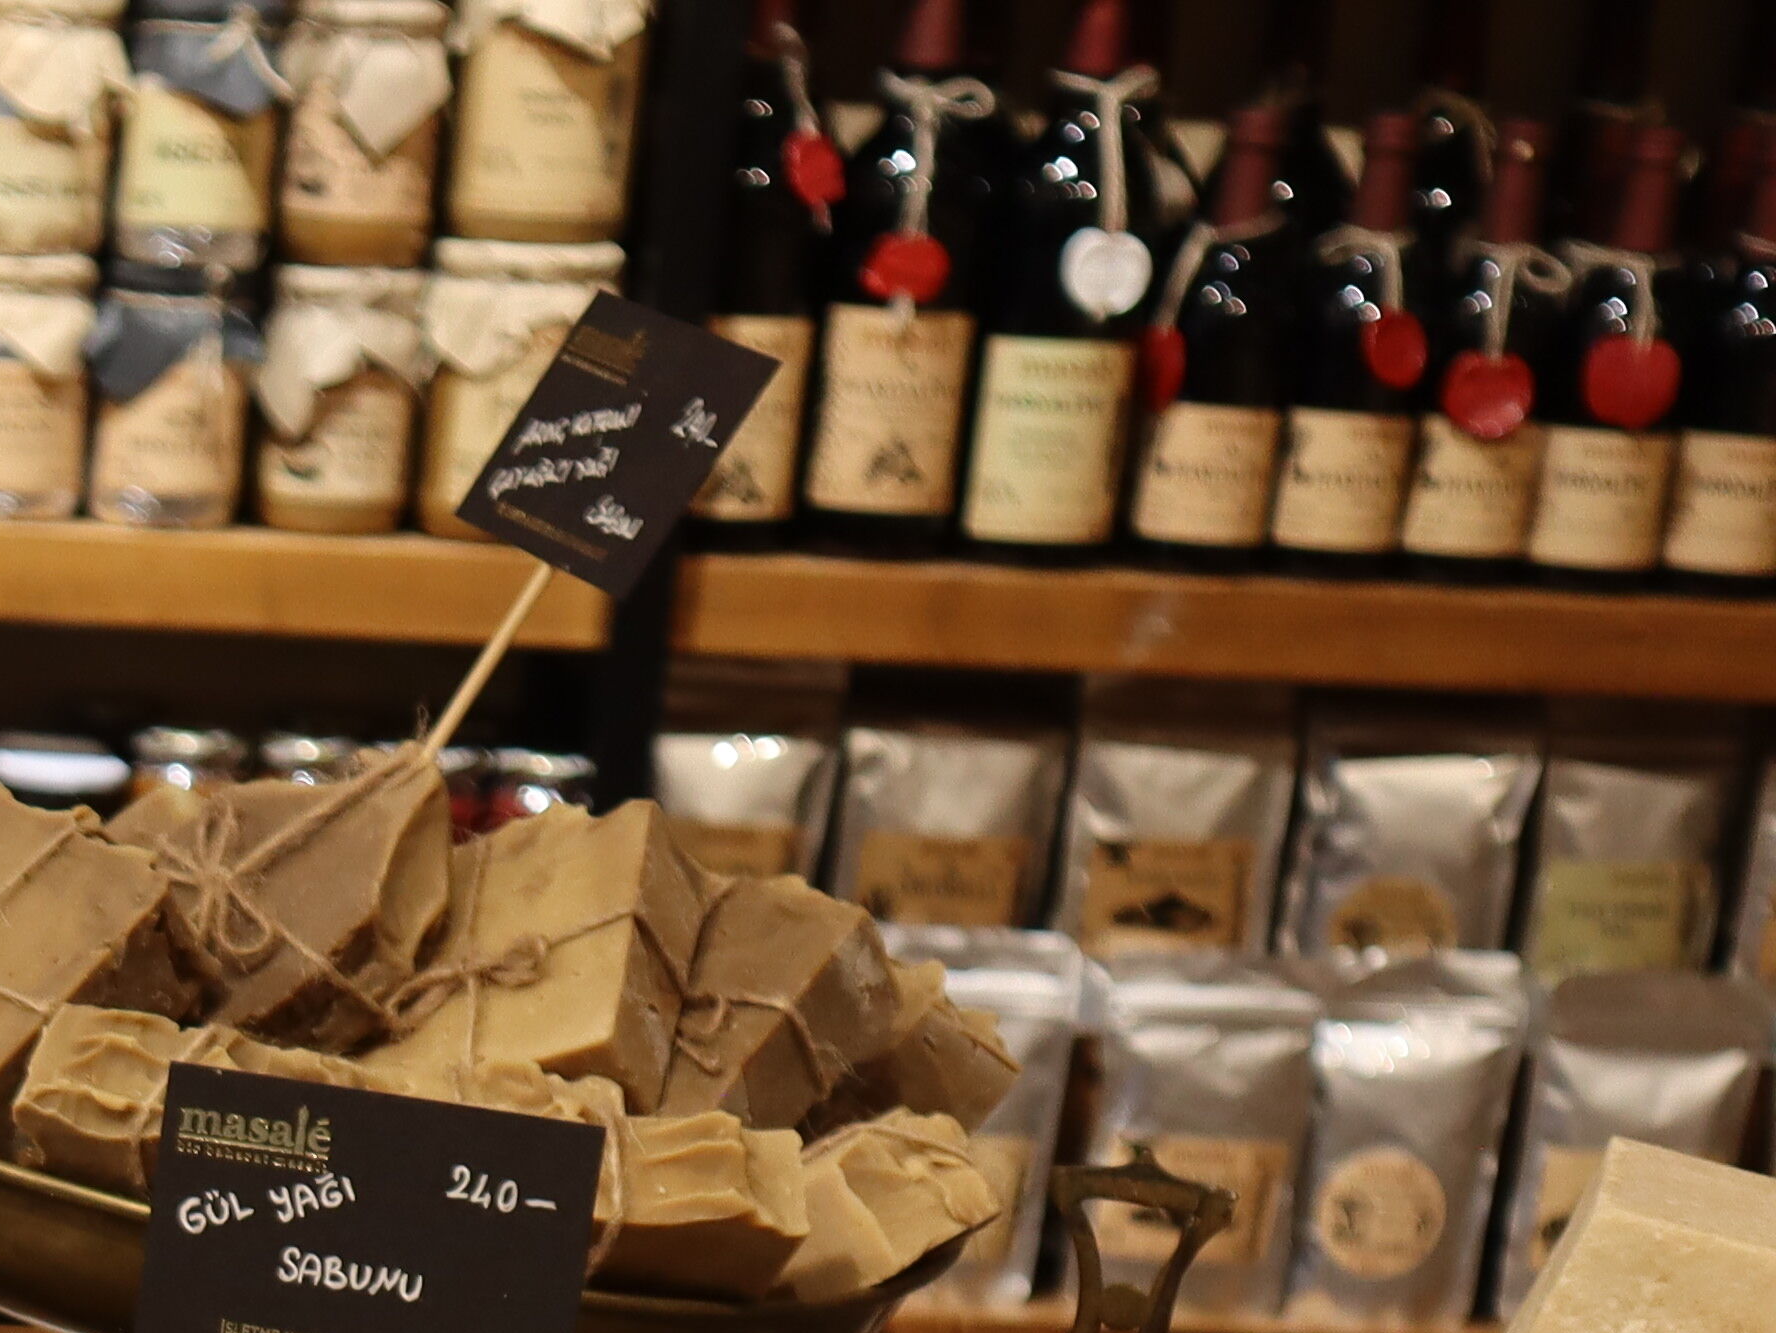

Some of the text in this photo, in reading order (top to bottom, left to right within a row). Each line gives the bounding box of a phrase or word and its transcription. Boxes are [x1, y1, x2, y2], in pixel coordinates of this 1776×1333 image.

[177, 1105, 332, 1158] masalé
[177, 1189, 254, 1235] GÜL
[267, 1171, 357, 1223] YAĞI
[276, 1246, 424, 1302] SABUNU
